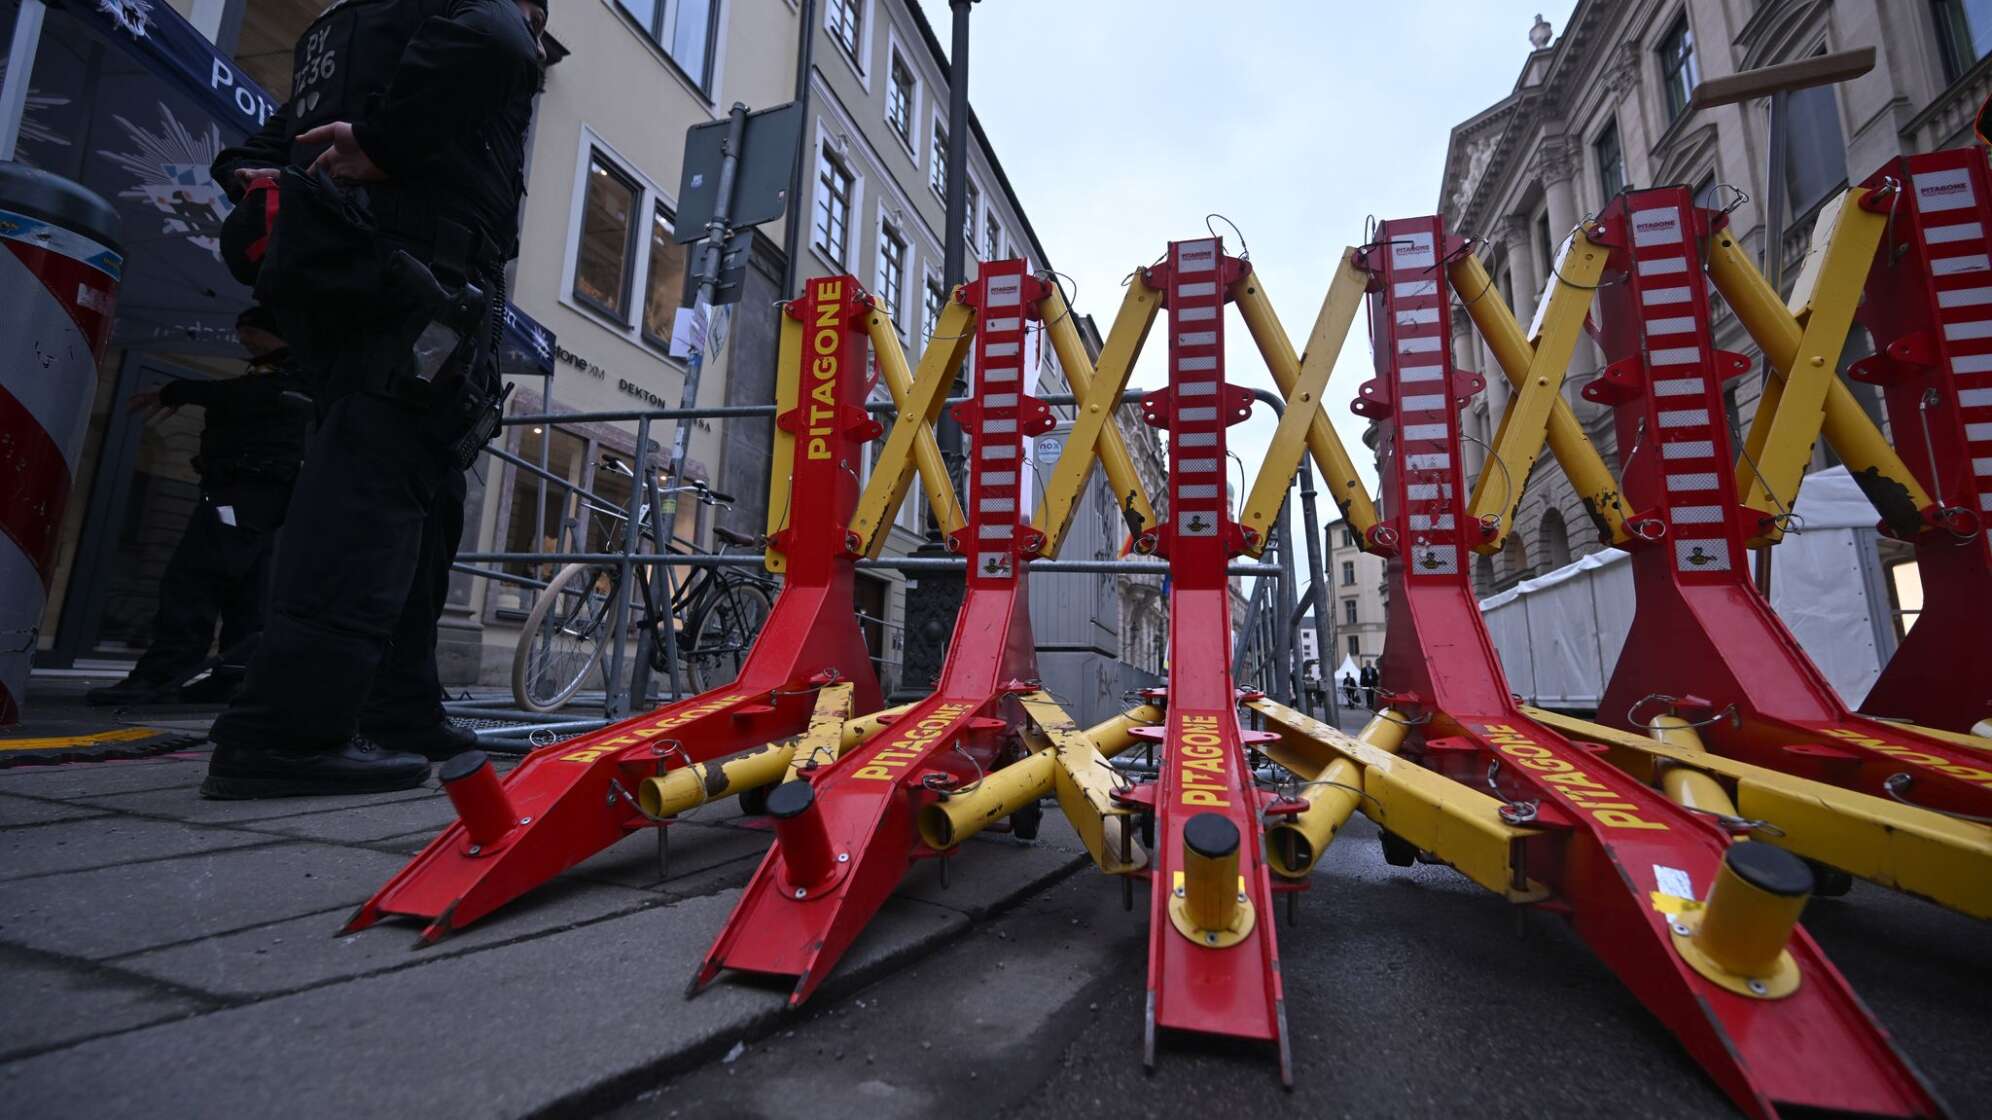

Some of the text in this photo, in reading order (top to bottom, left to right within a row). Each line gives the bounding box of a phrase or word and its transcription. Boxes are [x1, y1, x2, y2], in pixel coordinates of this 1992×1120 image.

[619, 378, 665, 409] DEKTON
[808, 280, 842, 461] PITAGONE
[851, 703, 974, 781] PITAGONE
[1181, 714, 1231, 807] PITAGONE
[1482, 724, 1670, 832] PITAGONE
